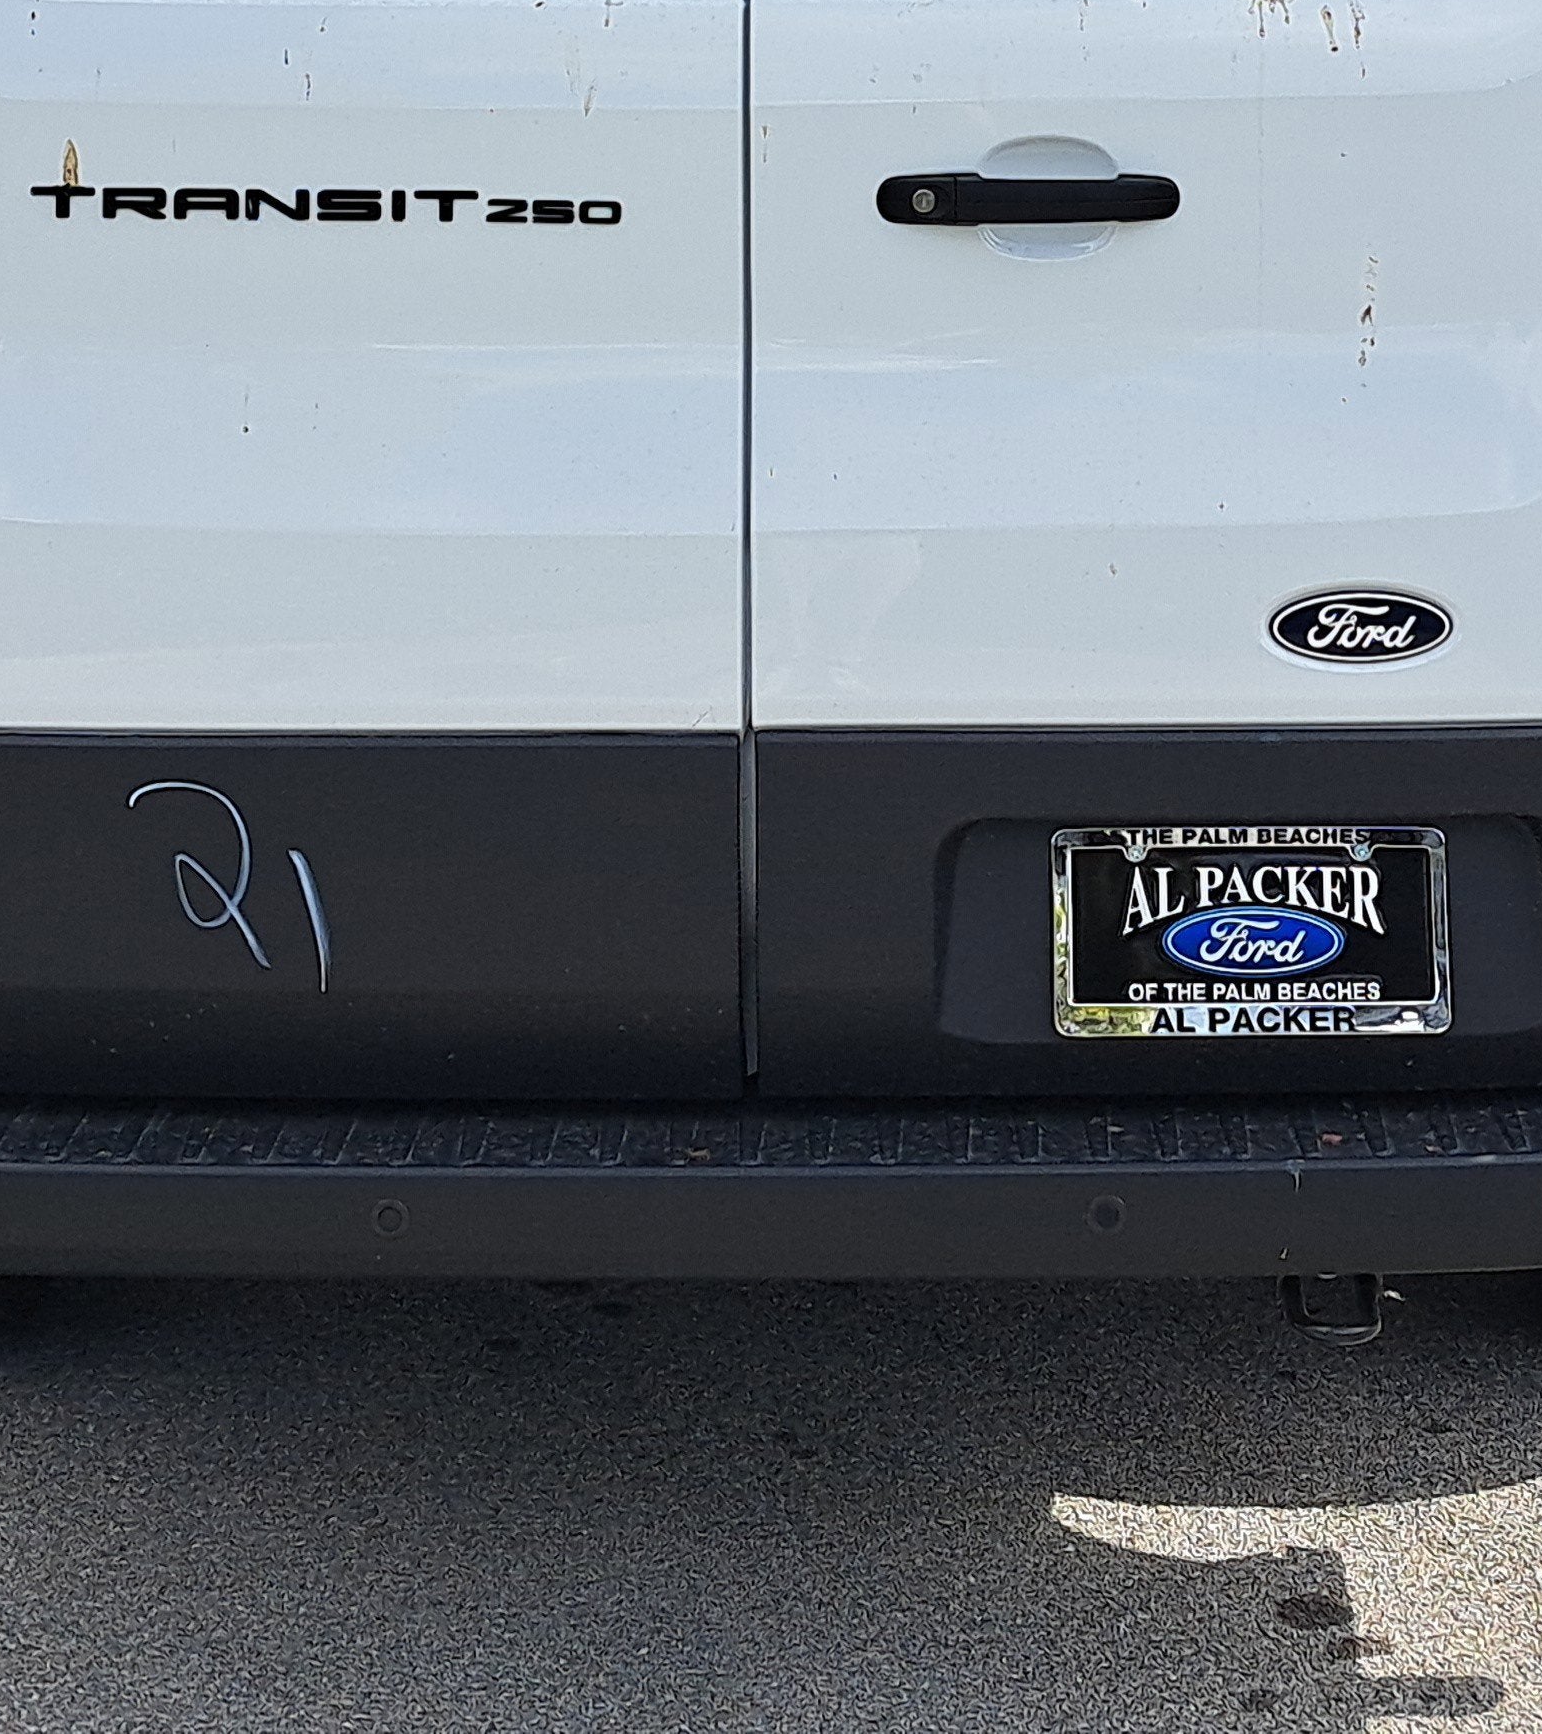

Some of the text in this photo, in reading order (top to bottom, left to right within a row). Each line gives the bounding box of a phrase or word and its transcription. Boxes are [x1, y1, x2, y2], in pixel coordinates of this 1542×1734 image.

[30, 182, 622, 225] TRANSIT 250
[1306, 602, 1417, 649] Ford
[1127, 828, 1371, 845] THE PALM BEACHES
[1122, 865, 1385, 936] AL PACKER
[1199, 917, 1307, 964] Ford
[1128, 981, 1382, 1002] OF THE PALM BEACHES
[1150, 1006, 1357, 1034] AL PACKER
